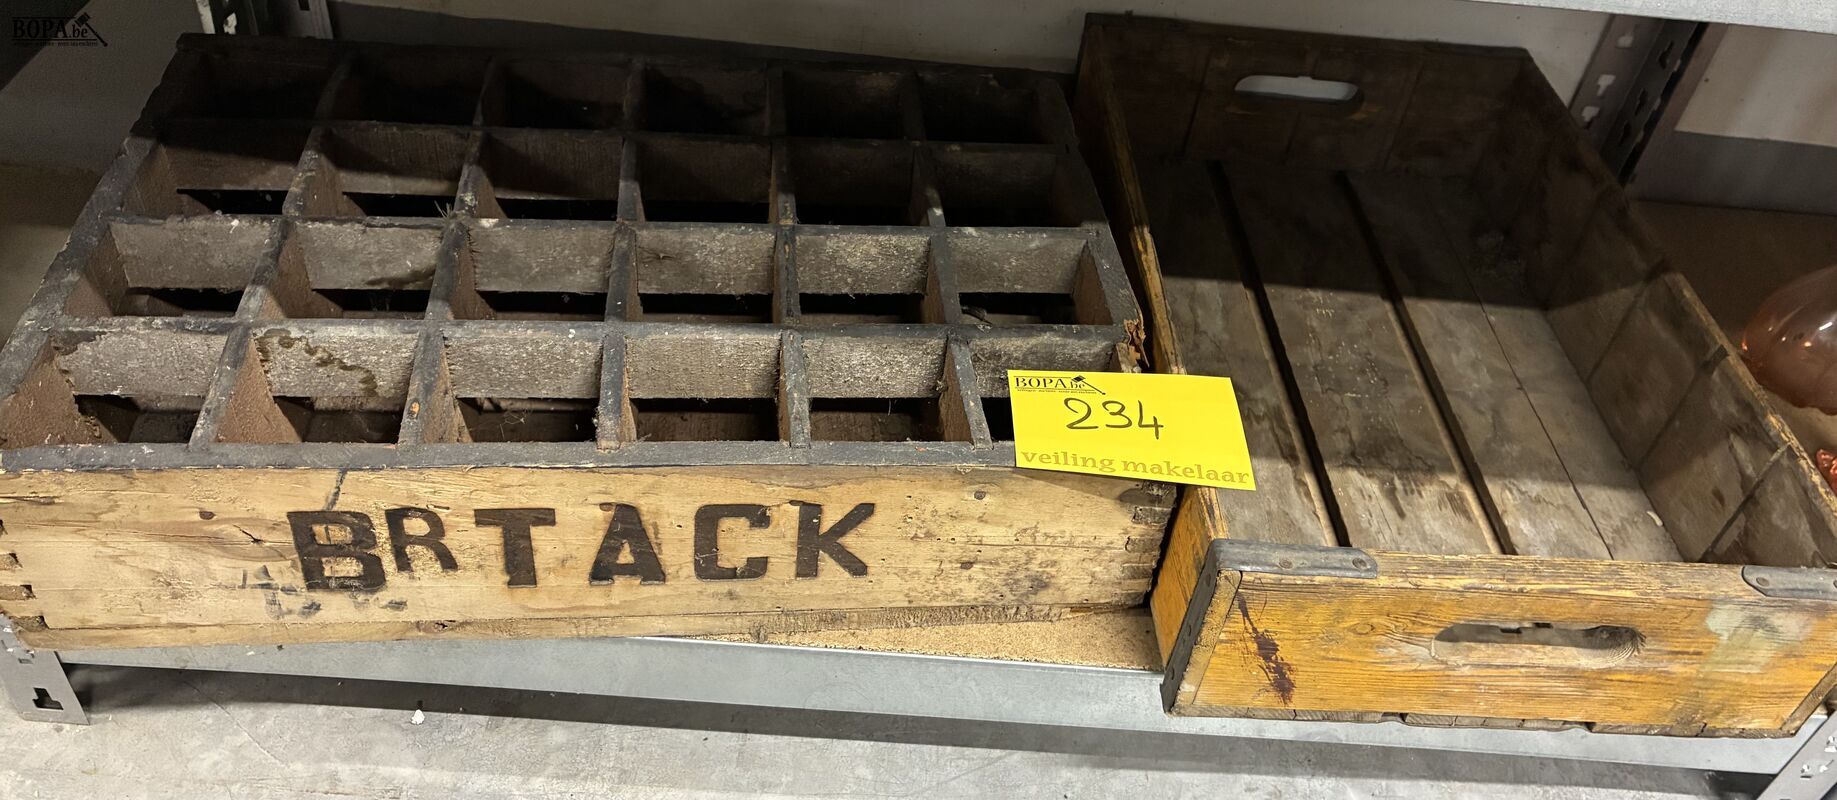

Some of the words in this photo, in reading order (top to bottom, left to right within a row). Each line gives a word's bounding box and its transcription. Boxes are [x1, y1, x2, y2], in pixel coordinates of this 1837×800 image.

[1063, 397, 1164, 440] 234
[1020, 450, 1114, 473] veiling
[1122, 459, 1250, 484] makelaar
